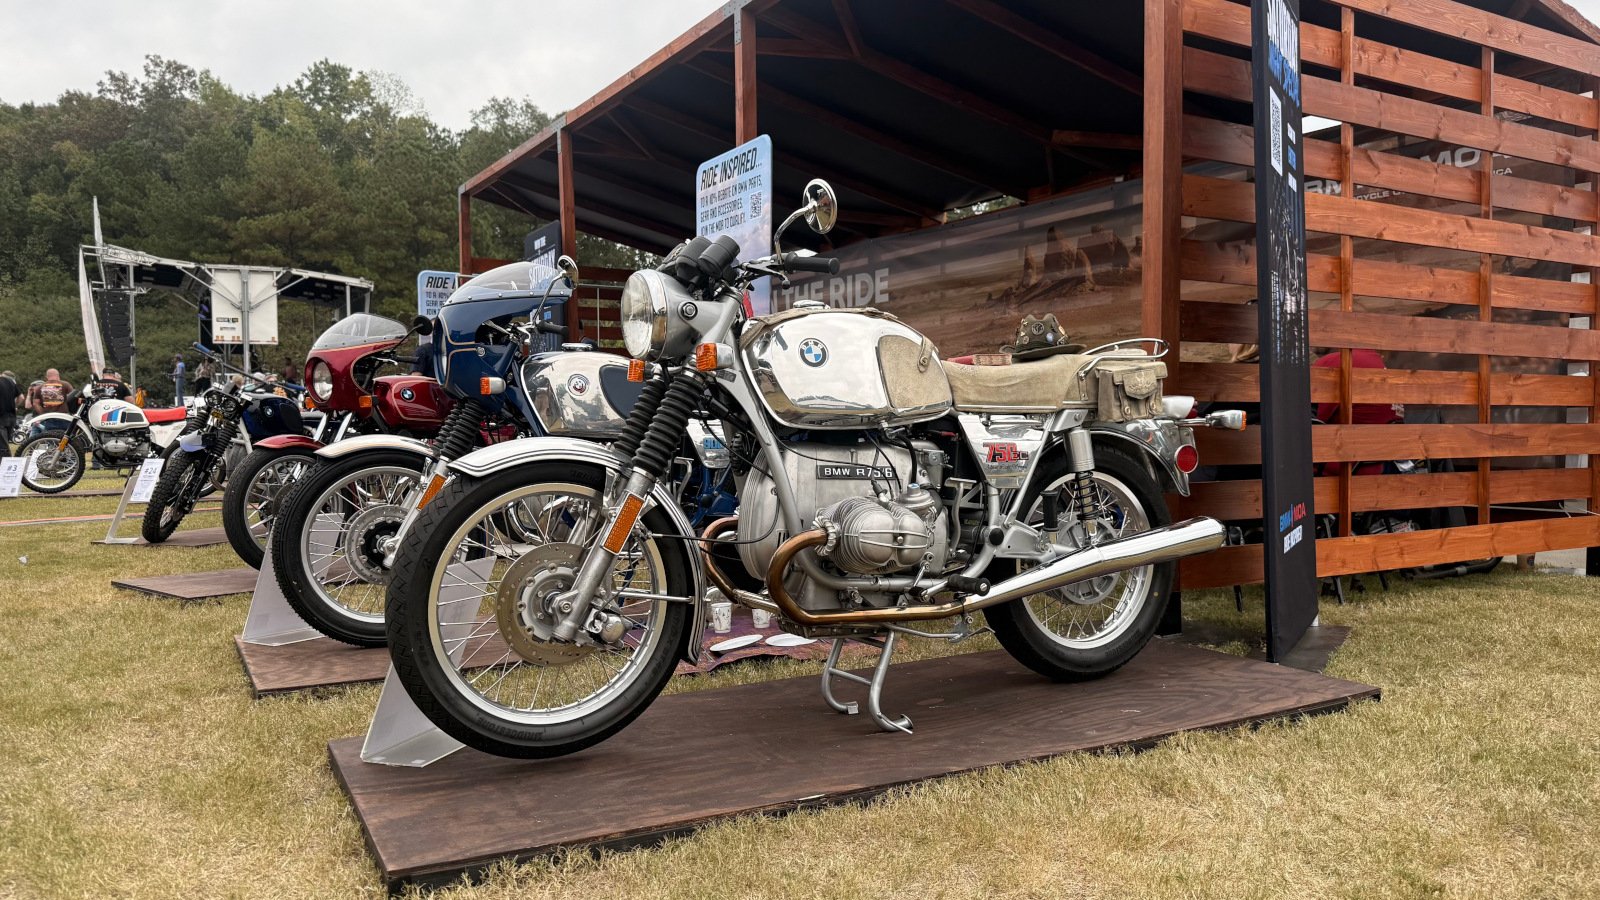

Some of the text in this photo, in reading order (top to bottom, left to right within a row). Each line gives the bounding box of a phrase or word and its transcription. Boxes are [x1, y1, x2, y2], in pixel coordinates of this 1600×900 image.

[700, 164, 718, 191] RIDE
[718, 186, 731, 201] REBATE
[738, 180, 748, 194] BMW
[426, 276, 450, 289] RIDE
[829, 267, 889, 309] RIDE
[982, 442, 1017, 463] 750
[824, 467, 851, 476] BMW
